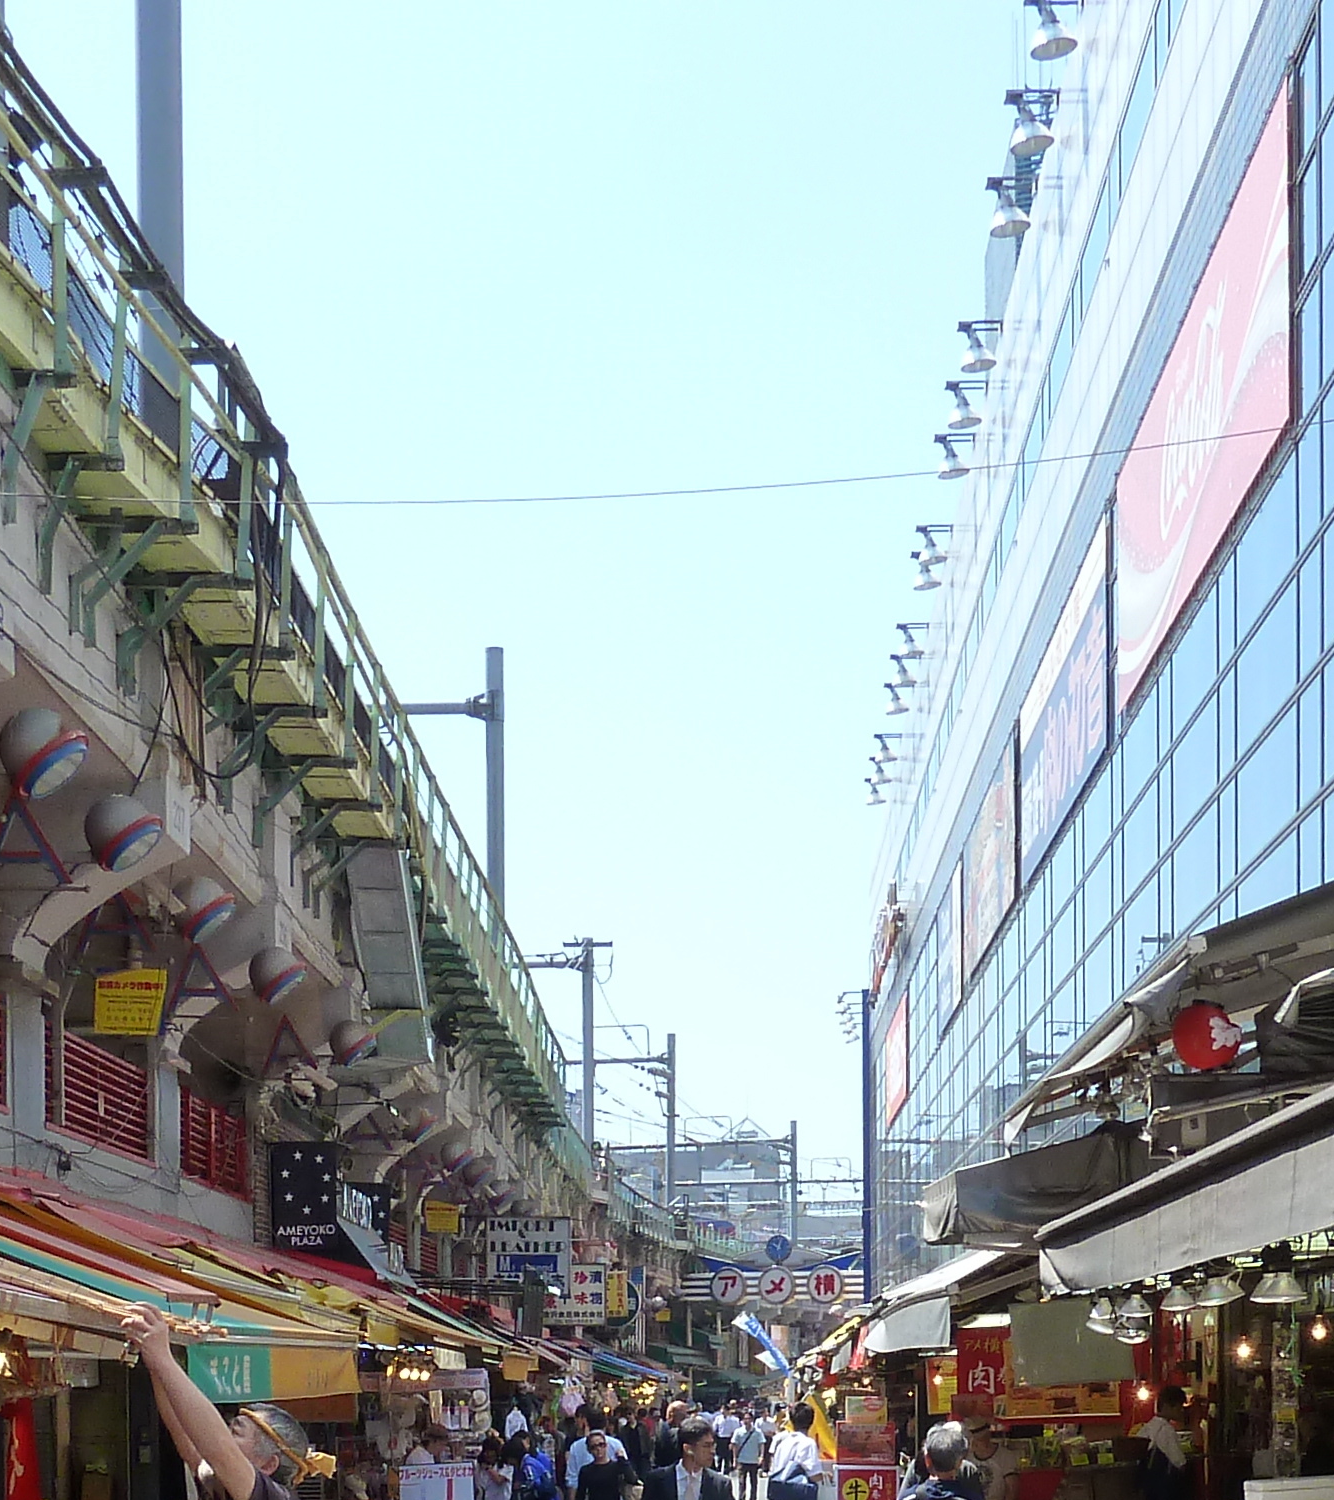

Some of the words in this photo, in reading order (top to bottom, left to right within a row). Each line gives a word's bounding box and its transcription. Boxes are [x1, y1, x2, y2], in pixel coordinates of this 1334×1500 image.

[277, 1224, 336, 1237] AMEYOKO
[489, 1220, 556, 1232] IMPORT
[291, 1236, 324, 1247] PLAZA
[490, 1241, 566, 1253] LEATHER
[717, 1273, 836, 1297] アメ横
